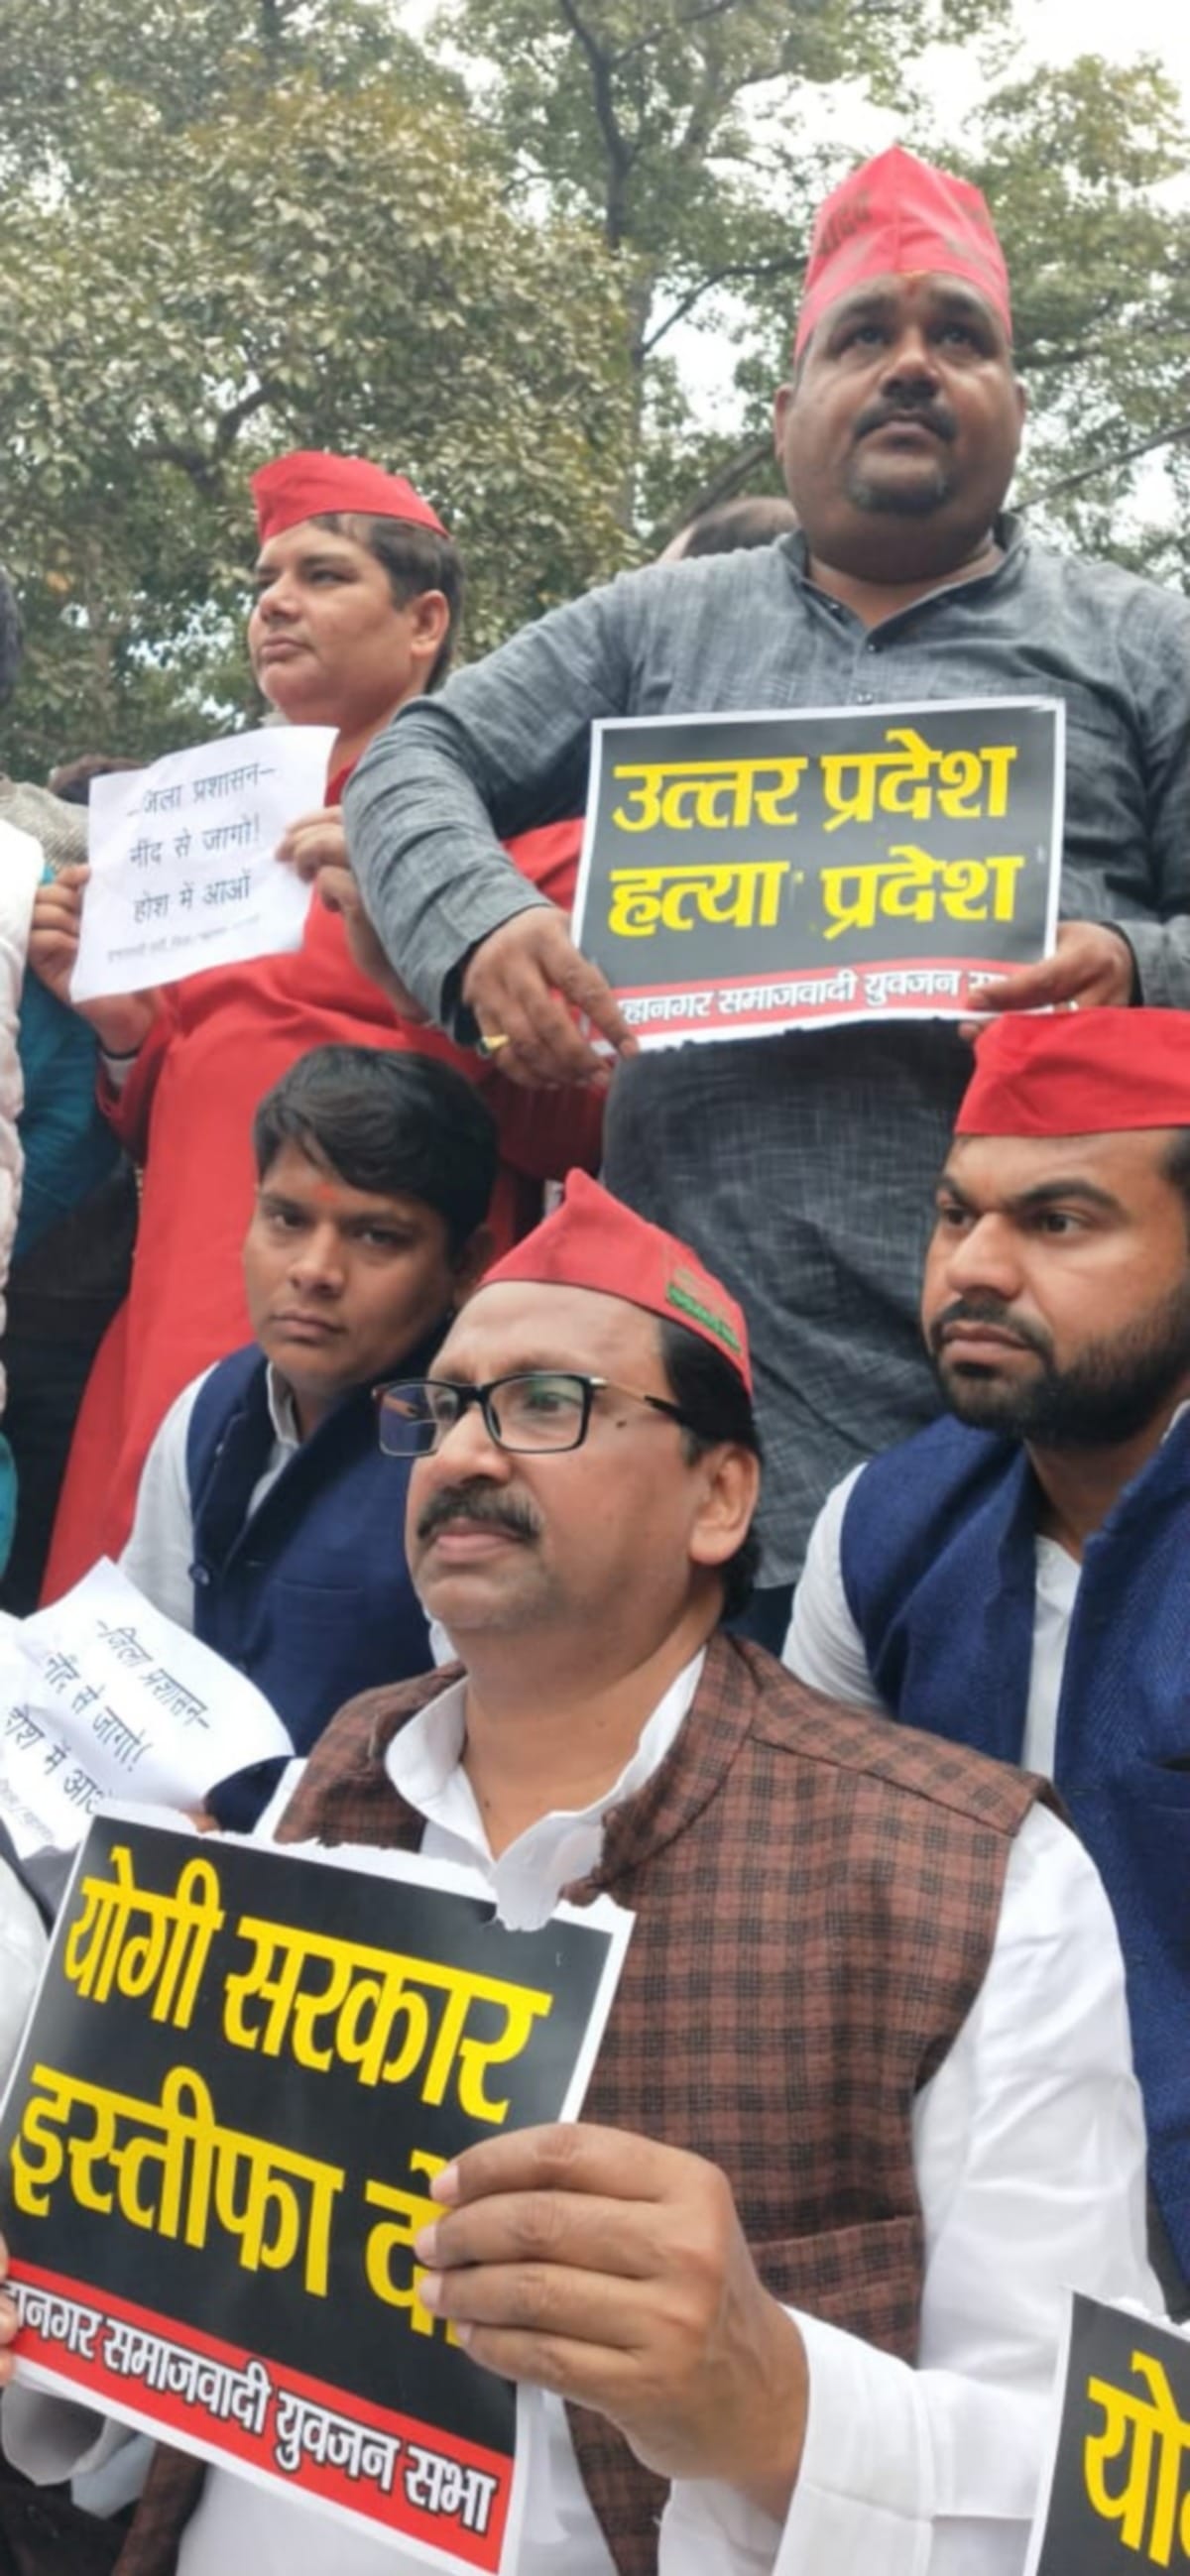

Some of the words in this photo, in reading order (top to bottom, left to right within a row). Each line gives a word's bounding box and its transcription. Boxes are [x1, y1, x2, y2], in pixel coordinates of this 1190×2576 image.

[611, 757, 808, 832] उत्तर
[820, 728, 1017, 833] प्रदेश
[174, 827, 191, 859] से
[134, 889, 170, 923] होश
[179, 880, 195, 909] में
[608, 861, 790, 937] हत्या
[820, 845, 1025, 939] प्रदेश
[617, 990, 715, 1025] हानगर
[717, 968, 859, 1014] समाजवादी
[864, 969, 963, 1006] युवजन
[71, 1684, 106, 1715] से
[45, 1738, 71, 1775] में
[62, 1846, 224, 2030] योगी
[222, 1916, 553, 2124] सरकार
[10, 2063, 345, 2298] इस्तीफा
[103, 2318, 272, 2433] समाजवादी
[276, 2390, 402, 2492] युवजन
[405, 2444, 498, 2534] सभा
[1084, 2349, 1190, 2568] यो
